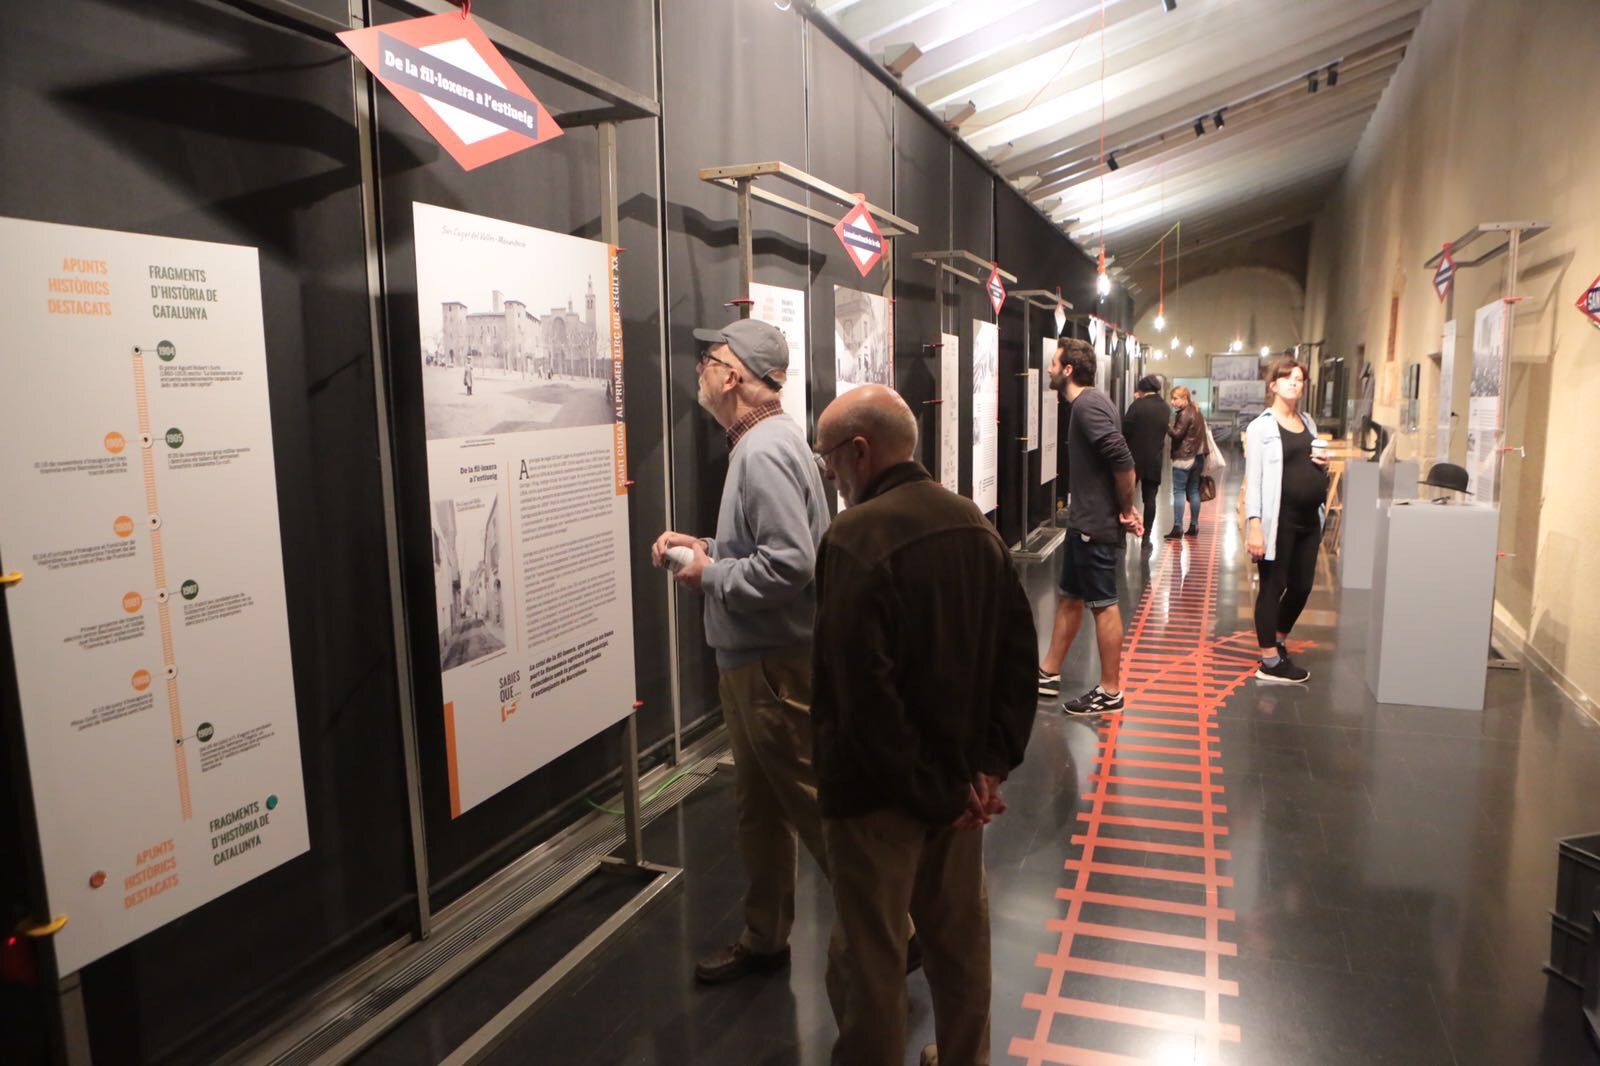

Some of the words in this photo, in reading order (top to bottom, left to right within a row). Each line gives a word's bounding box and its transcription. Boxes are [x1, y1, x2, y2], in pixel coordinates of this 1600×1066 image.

[384, 50, 404, 72] De
[405, 58, 418, 78] la
[476, 93, 484, 105] a
[484, 94, 534, 129] l'estiueig
[63, 257, 108, 275] APUNTS
[611, 255, 619, 271] XX
[149, 264, 207, 283] FRAGMENTS
[48, 277, 110, 296] HISTÒRICS
[150, 284, 205, 302] D'HISTÒRIA
[206, 289, 218, 302] DE
[612, 274, 620, 308] SEGLE
[48, 298, 112, 317] DESTACATS
[152, 304, 208, 321] CATALUNYA
[613, 311, 621, 330] DEL
[614, 361, 623, 403] PRIMER
[616, 404, 624, 418] AL
[167, 433, 183, 444] 1905
[617, 420, 625, 456] CUGAT
[519, 459, 529, 480] A
[183, 584, 197, 596] 1907
[499, 670, 520, 689] SABIES
[209, 801, 259, 833] FRAGMENTS
[212, 817, 259, 850] D'HISTÒRIA
[260, 813, 270, 829] DE
[136, 837, 176, 867] APUNTS
[213, 834, 262, 867] CATALUNYA
[124, 874, 179, 910] DESTACATS
